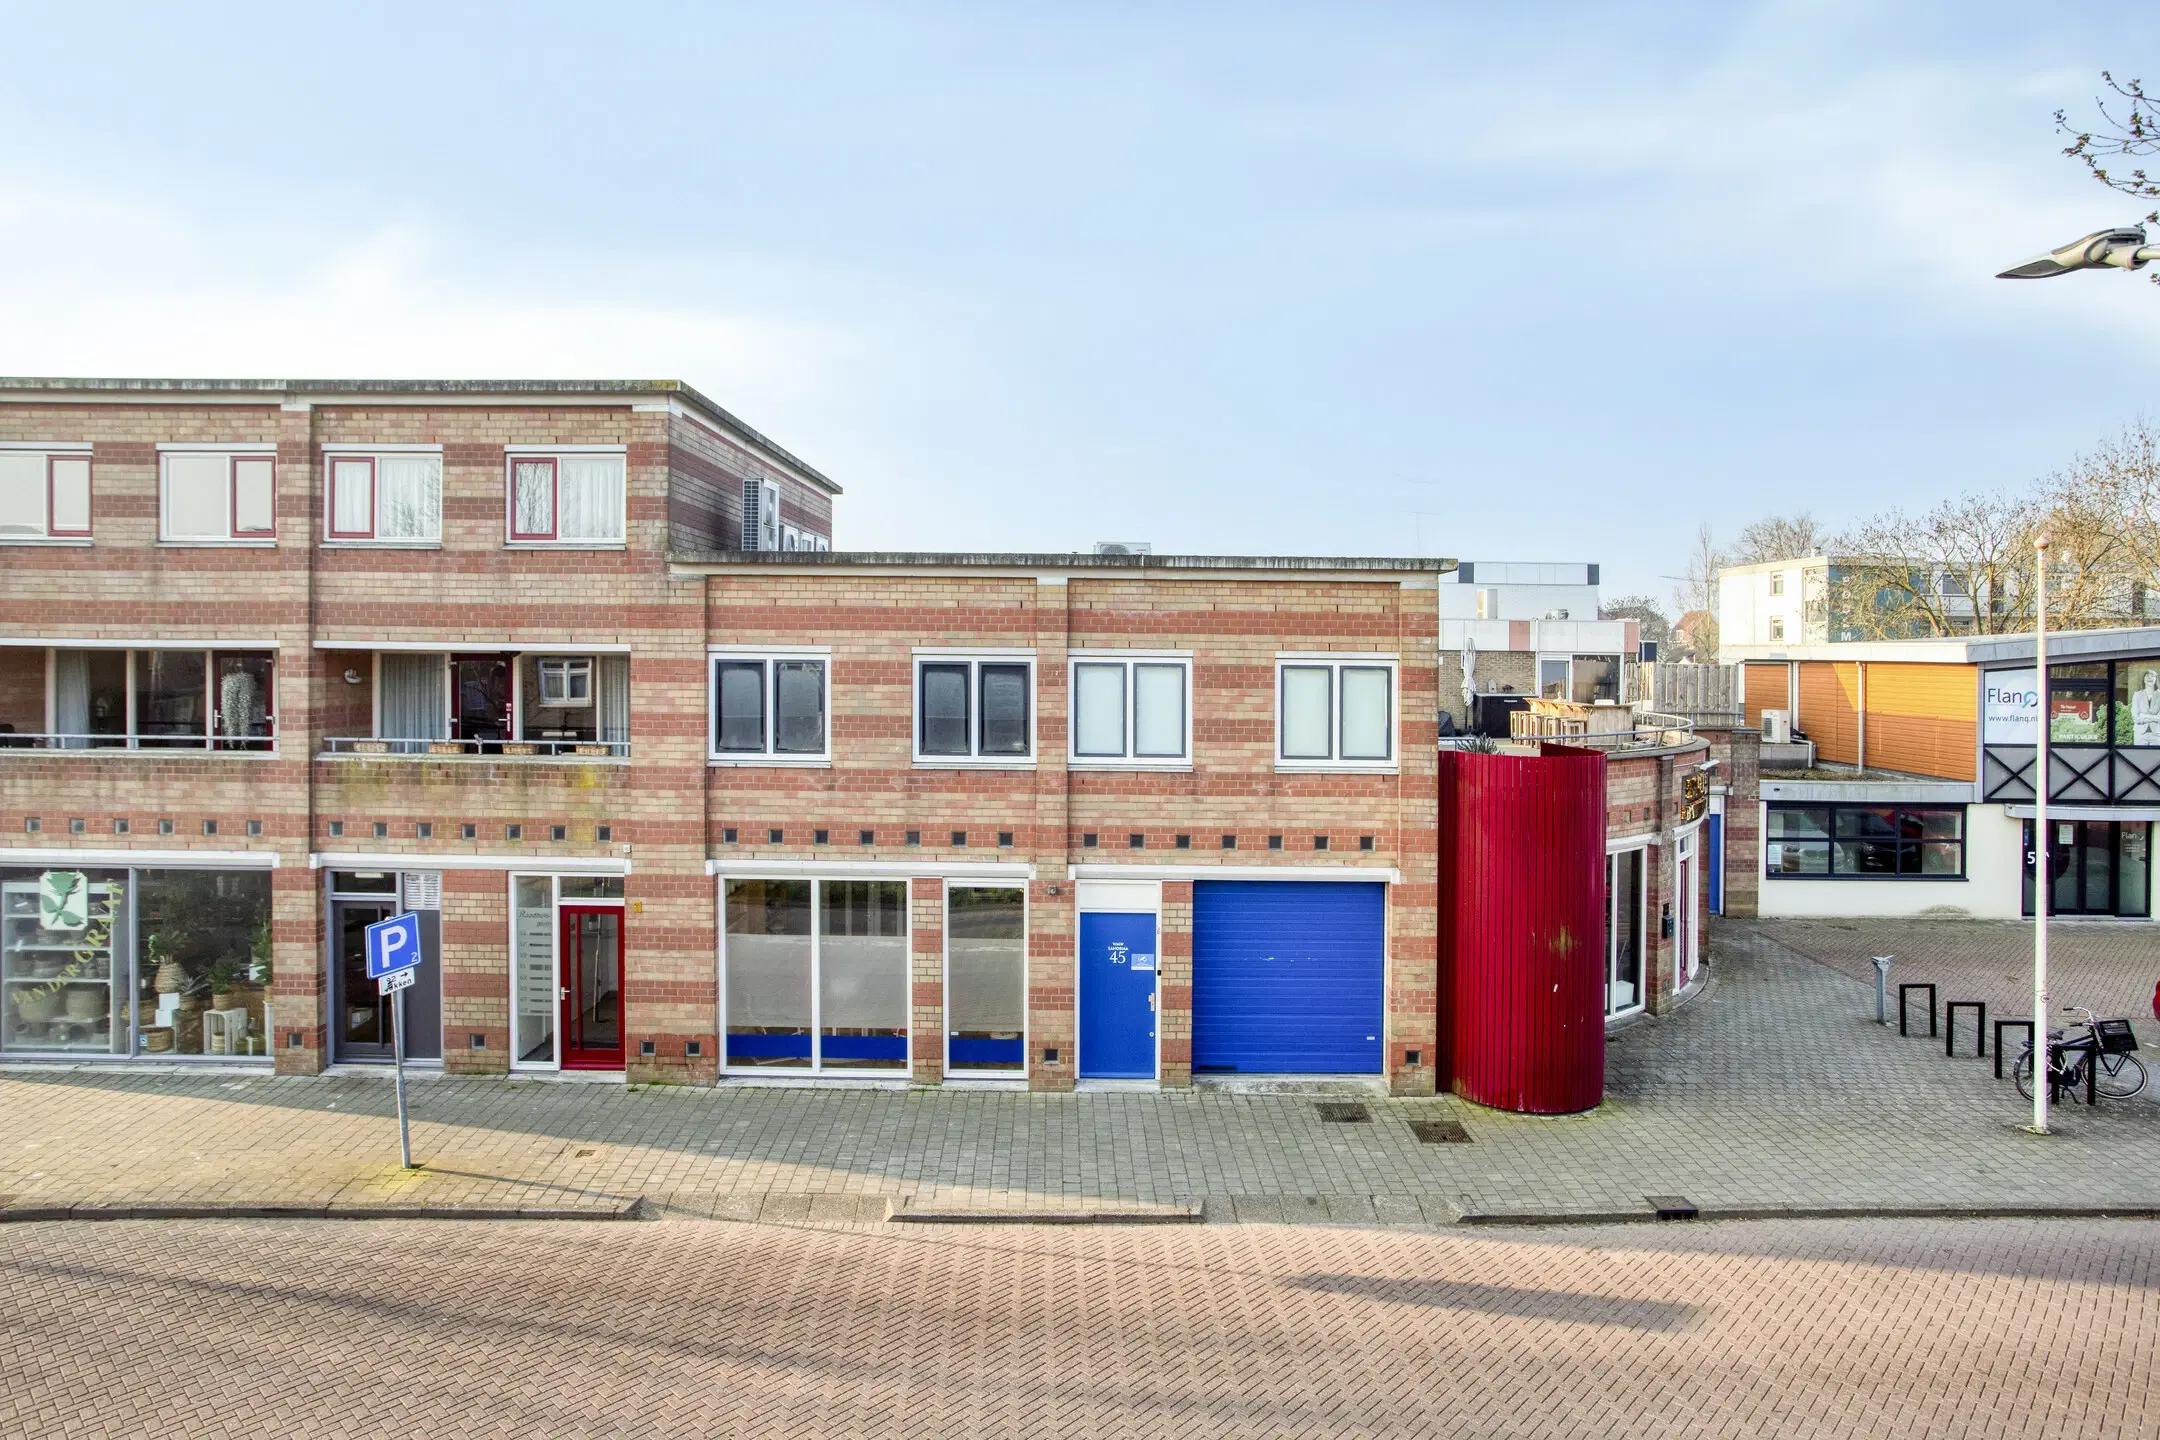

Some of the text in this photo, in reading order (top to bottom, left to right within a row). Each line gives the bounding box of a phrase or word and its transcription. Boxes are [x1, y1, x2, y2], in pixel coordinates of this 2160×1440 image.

[73, 878, 124, 963] GRAAF
[380, 925, 408, 969] P
[410, 951, 418, 963] 2
[1109, 950, 1126, 964] 45
